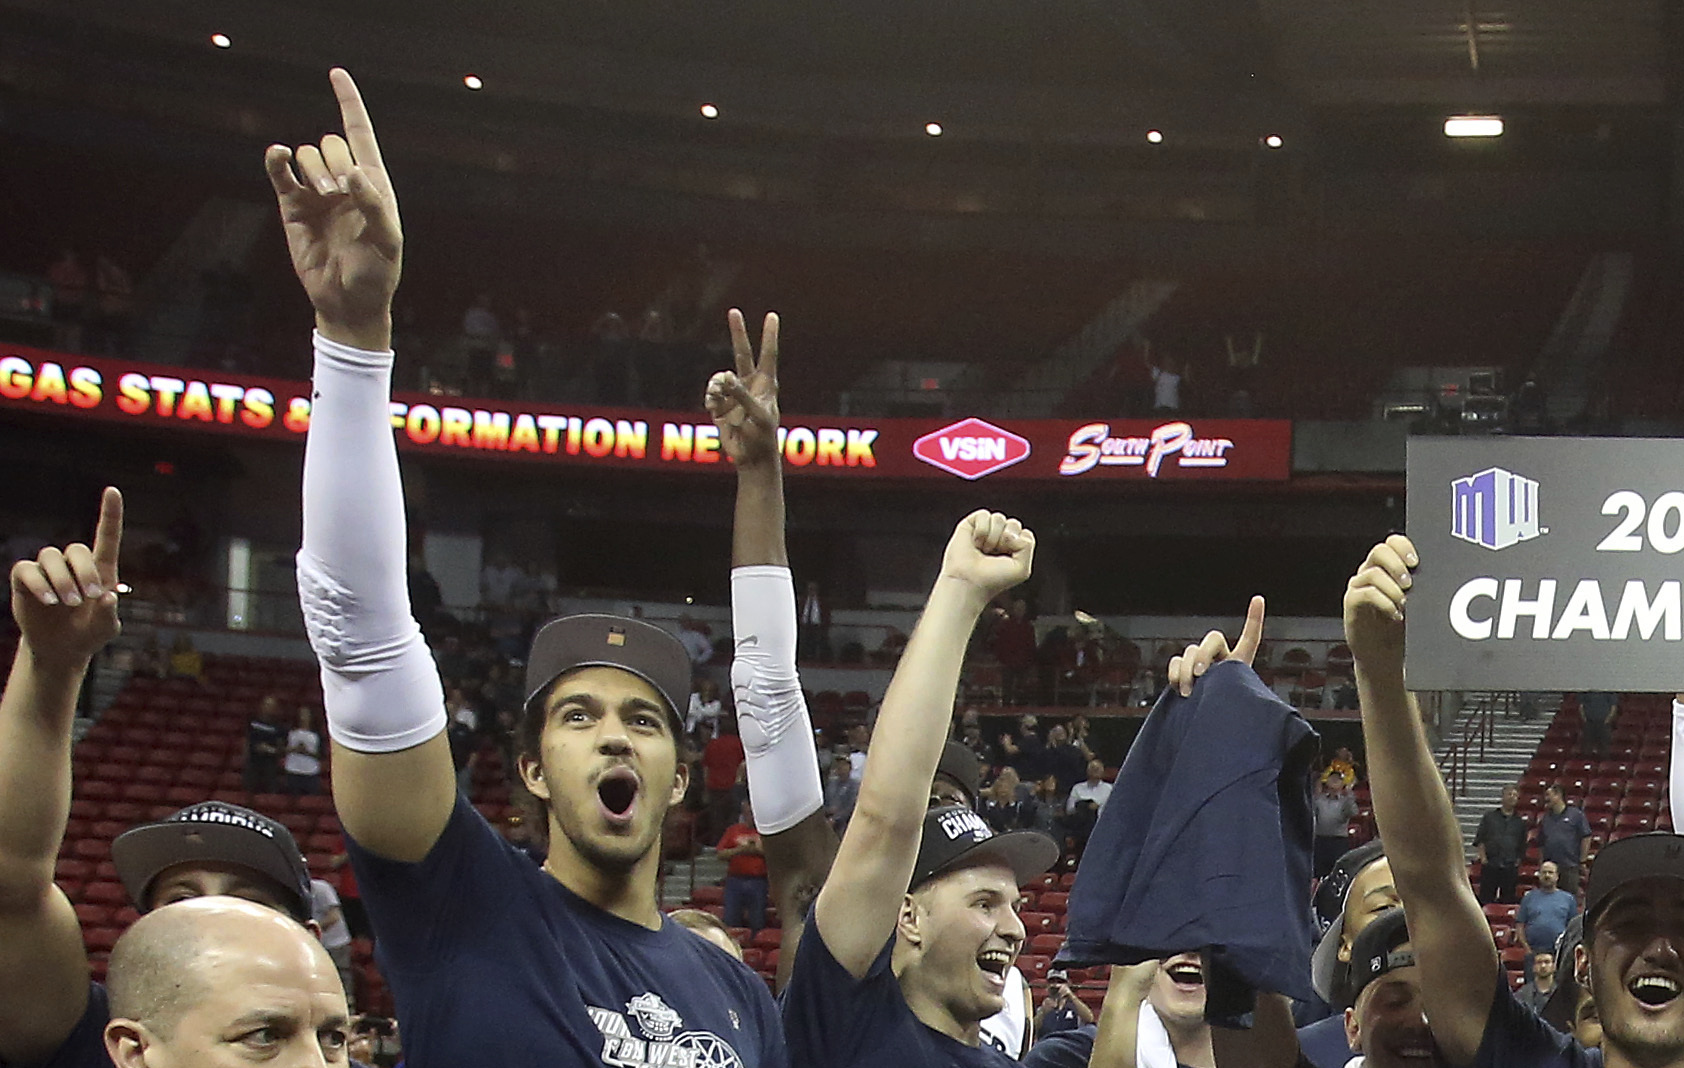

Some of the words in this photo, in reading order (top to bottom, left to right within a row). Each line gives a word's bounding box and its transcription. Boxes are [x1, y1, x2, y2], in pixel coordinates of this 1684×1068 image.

[117, 373, 275, 428] STATS
[387, 402, 648, 459] FORMATION
[661, 422, 879, 468] NEORK
